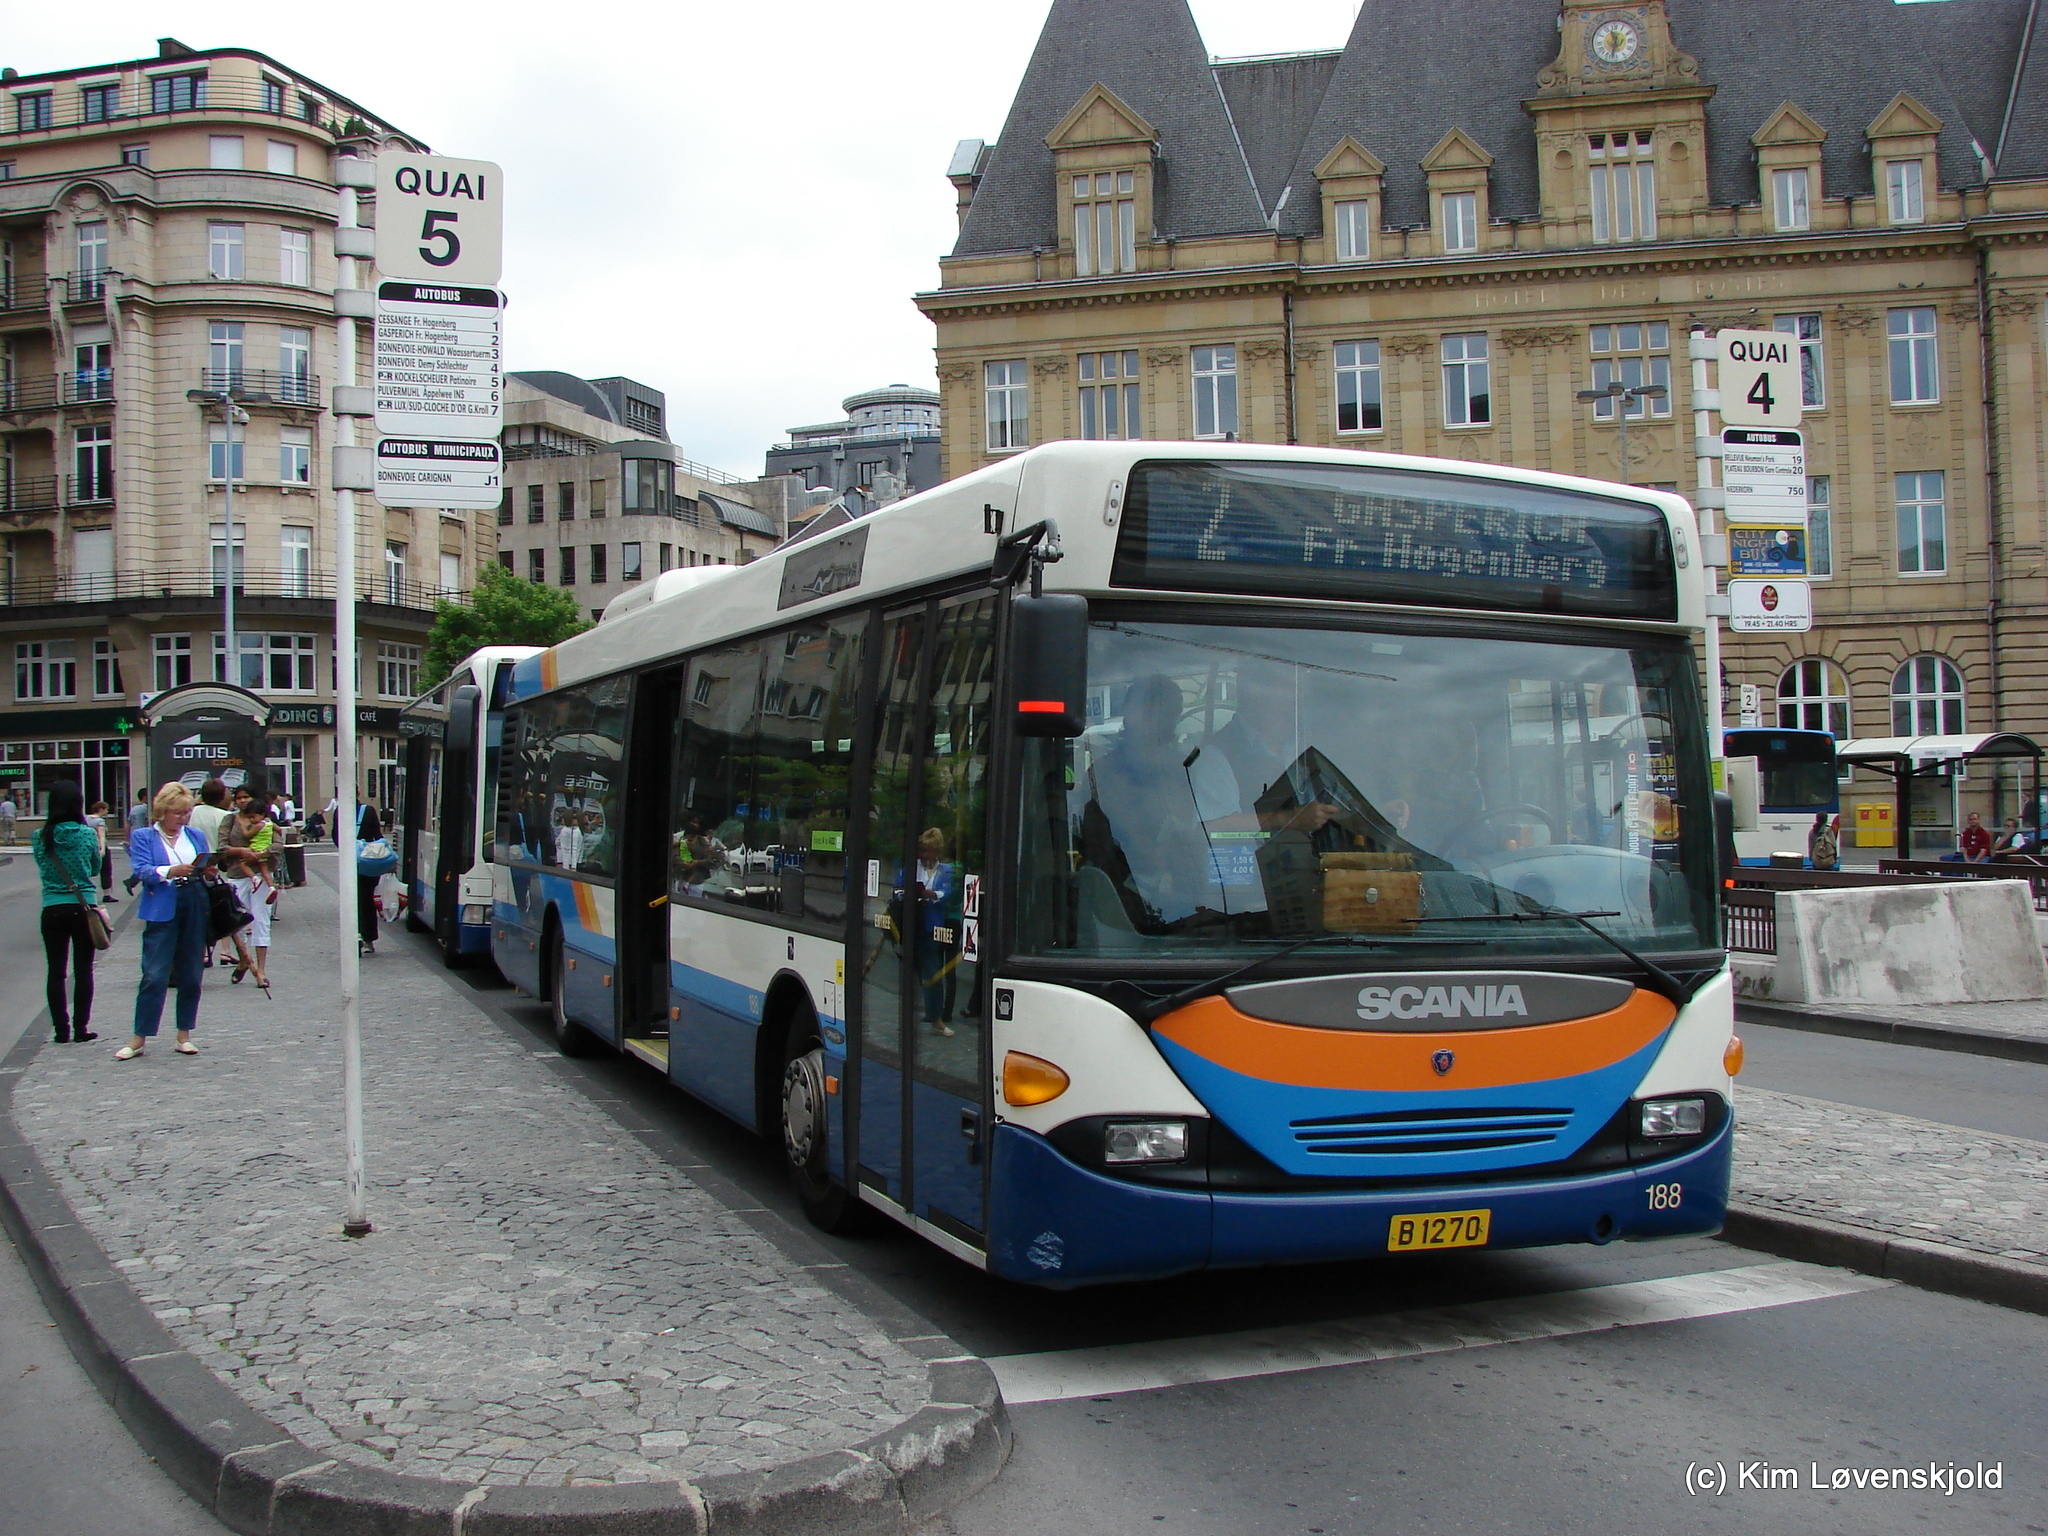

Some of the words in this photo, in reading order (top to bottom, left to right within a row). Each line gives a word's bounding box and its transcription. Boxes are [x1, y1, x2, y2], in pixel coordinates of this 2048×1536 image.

[395, 166, 485, 201] QUAI
[418, 209, 461, 267] 5
[415, 287, 461, 302] AUTOBUS
[378, 314, 412, 326] CESSANGE
[413, 317, 422, 326] Fr.
[422, 318, 457, 330] Hogenberg
[492, 321, 499, 331] 1
[378, 328, 414, 339] GASPERICH
[415, 330, 423, 340] Fr.
[424, 331, 458, 344] Hogenberg
[491, 336, 499, 346] 2
[378, 342, 446, 356] BONNEVOIE-HOWALD
[491, 350, 499, 360] 3
[1729, 340, 1788, 364] QUAI
[378, 356, 416, 368] BONNEVOIE
[418, 359, 435, 372] Demy
[436, 360, 469, 371] Schlechter
[491, 364, 499, 374] 4
[394, 372, 449, 384] KOCKELSCHEUER
[449, 376, 477, 386] Patinoire
[491, 378, 499, 388] 5
[453, 390, 465, 400] INS
[491, 392, 499, 402] 6
[1747, 372, 1775, 415] 4
[450, 403, 467, 414] D'OR
[491, 406, 499, 416] 7
[1746, 433, 1777, 443] AUTOBUS
[382, 442, 428, 455] AUTOBUS
[434, 445, 495, 458] MUNICIPAUX
[1792, 456, 1802, 465] 19
[378, 471, 416, 482] BONNEVOIE
[418, 472, 452, 483] CARIGNAN
[485, 475, 499, 486] J1
[1792, 466, 1803, 475] 20
[1787, 487, 1804, 495] 750
[1198, 478, 1230, 561] 2
[1333, 493, 1585, 544] GASPERICH
[1735, 530, 1766, 539] CITY
[1732, 540, 1776, 548] NIGHT
[1303, 525, 1367, 566] Fr.
[1383, 531, 1607, 589] Hogenberg
[1740, 547, 1767, 562] BUS
[1746, 695, 1752, 706] 2
[360, 710, 377, 722] CAFÉ
[173, 746, 229, 759] LOTUS
[212, 757, 243, 766] code
[874, 914, 891, 930] ENTREE
[933, 925, 953, 944] ENTREE
[1356, 984, 1529, 1021] SCANIA
[1645, 1183, 1682, 1210] 188
